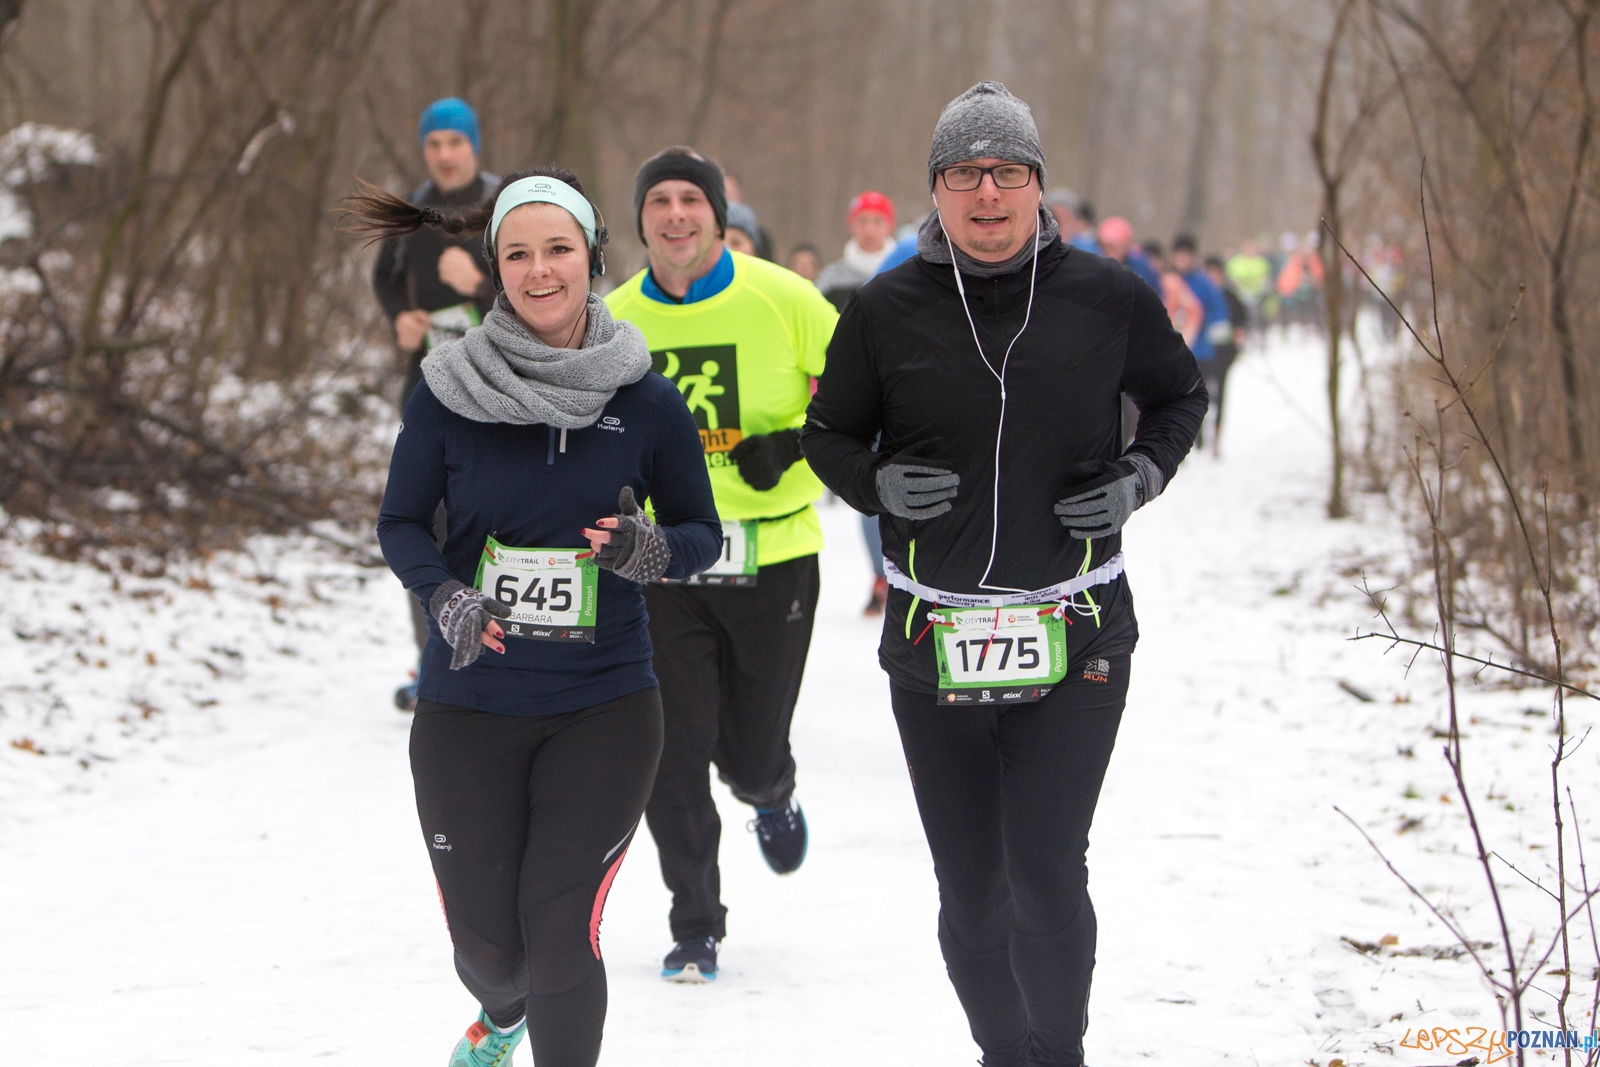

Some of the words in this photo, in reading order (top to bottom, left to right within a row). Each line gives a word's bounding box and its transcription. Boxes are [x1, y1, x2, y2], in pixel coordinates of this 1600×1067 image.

[597, 423, 625, 434] Kalenji
[495, 574, 573, 612] 645
[938, 594, 990, 604] performance
[585, 585, 593, 617] Poznań
[946, 599, 976, 607] recovery
[509, 611, 554, 624] BARBARA
[955, 637, 1040, 672] 1775
[1083, 674, 1108, 683] RUN
